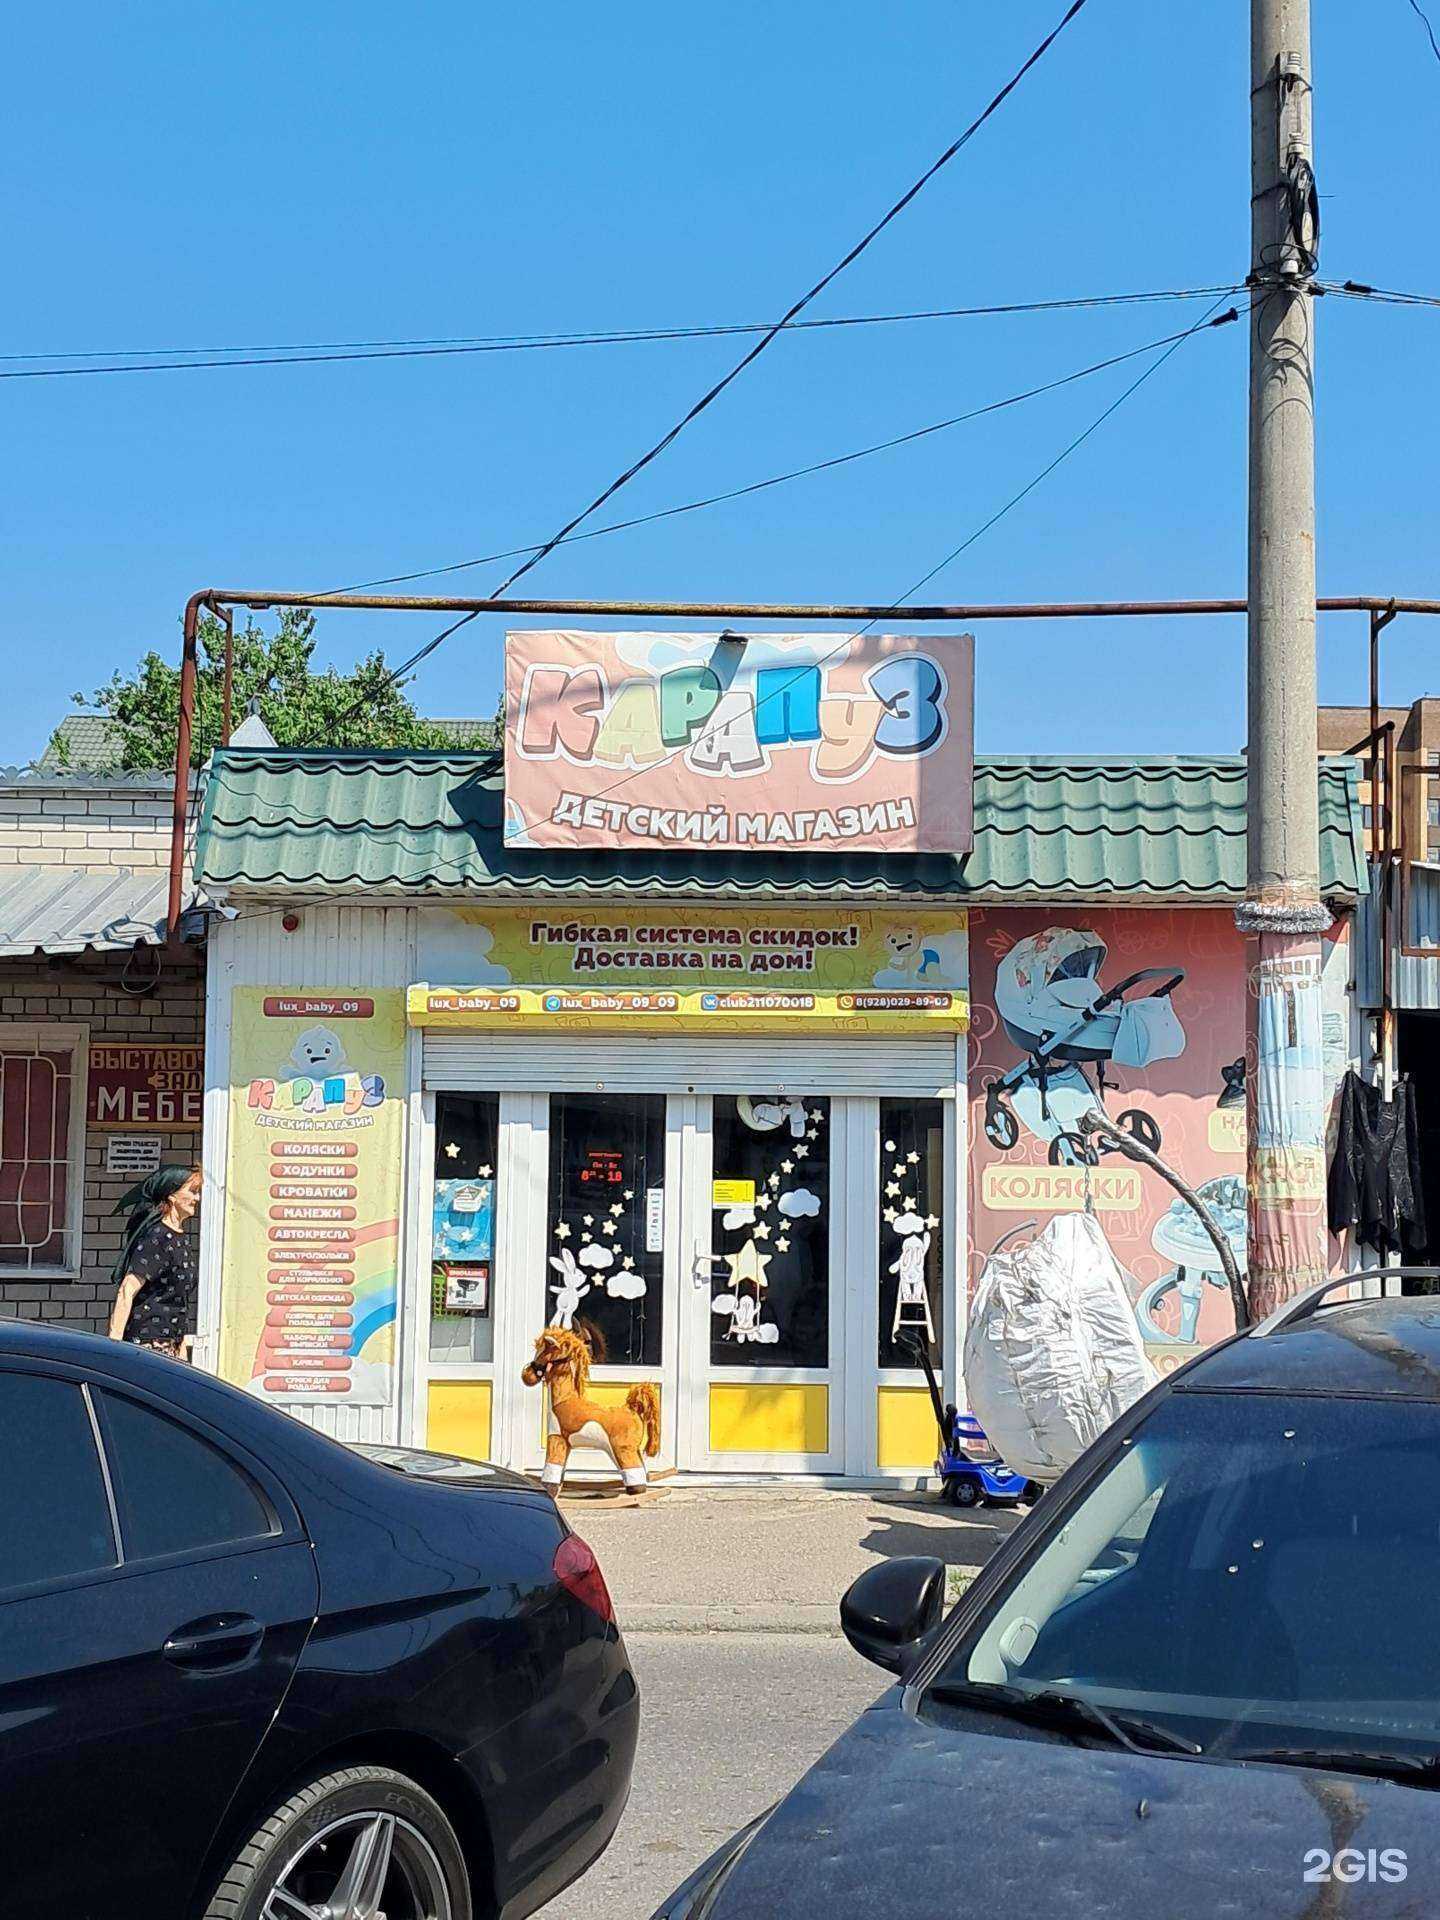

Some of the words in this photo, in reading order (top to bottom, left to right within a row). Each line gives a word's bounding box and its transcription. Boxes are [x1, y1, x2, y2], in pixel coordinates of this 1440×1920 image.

[519, 654, 946, 778] КАРАПУЗ
[553, 790, 728, 842] ДЕТСКИЙ
[736, 797, 917, 843] МАГАЗИН
[532, 923, 628, 943] Гибкая
[636, 926, 741, 945] система
[749, 926, 858, 948] скидок!
[574, 947, 703, 969] Доставка
[711, 953, 743, 968] на
[750, 951, 813, 971] дом!
[279, 1002, 359, 1014] lux_baby_09
[429, 997, 517, 1010] lux_baby_09
[562, 997, 676, 1011] lux_baby_09_09
[248, 1075, 386, 1115] КАРАПУЗ
[255, 1114, 315, 1131] ДЕТСКИЙ
[315, 1115, 375, 1131] МАГАЗИН
[283, 1144, 346, 1155] КОЛЯСКИ
[282, 1165, 345, 1177] ХОДУНКИ
[279, 1186, 348, 1198] КРОВАТКИ
[989, 1176, 1135, 1200] КОЛЯСКИ
[283, 1208, 342, 1218] МАНЕЖИ
[275, 1229, 350, 1240] АВТОКРЕСЛА
